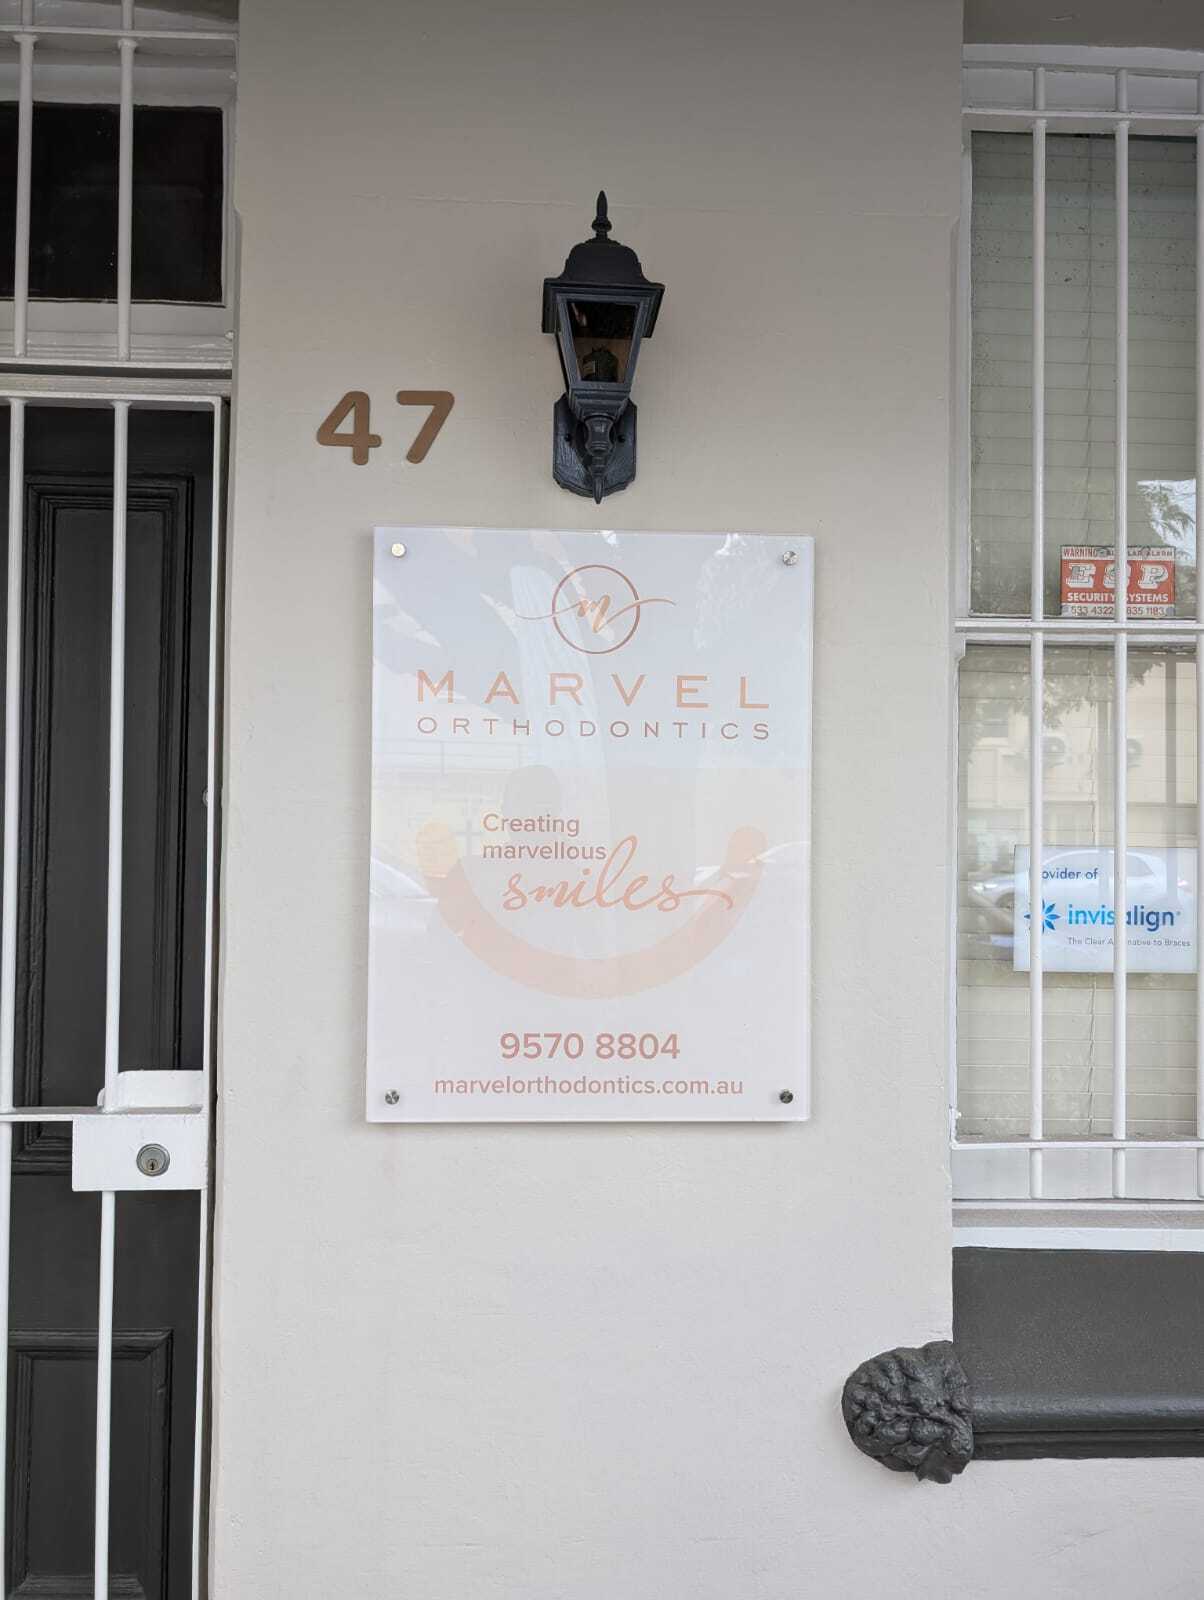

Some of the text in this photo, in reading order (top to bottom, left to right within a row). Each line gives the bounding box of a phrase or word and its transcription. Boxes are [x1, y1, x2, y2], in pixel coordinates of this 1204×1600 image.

[317, 391, 455, 465] 47
[1064, 547, 1097, 557] WARNING
[1067, 592, 1116, 602] SECURITY
[416, 669, 770, 710] MARVEL
[417, 716, 770, 741] ORTHODONTICS
[482, 812, 580, 838] Creating
[482, 840, 607, 861] marvellous
[502, 835, 734, 912] smiles
[1085, 867, 1099, 880] of
[1067, 936, 1083, 945] The
[1084, 936, 1105, 945] Clear
[1152, 938, 1162, 946] to
[1164, 938, 1191, 947] Braces
[500, 1032, 681, 1061] 9570 8804
[434, 1075, 744, 1096] marvelorthodontics.com.au
